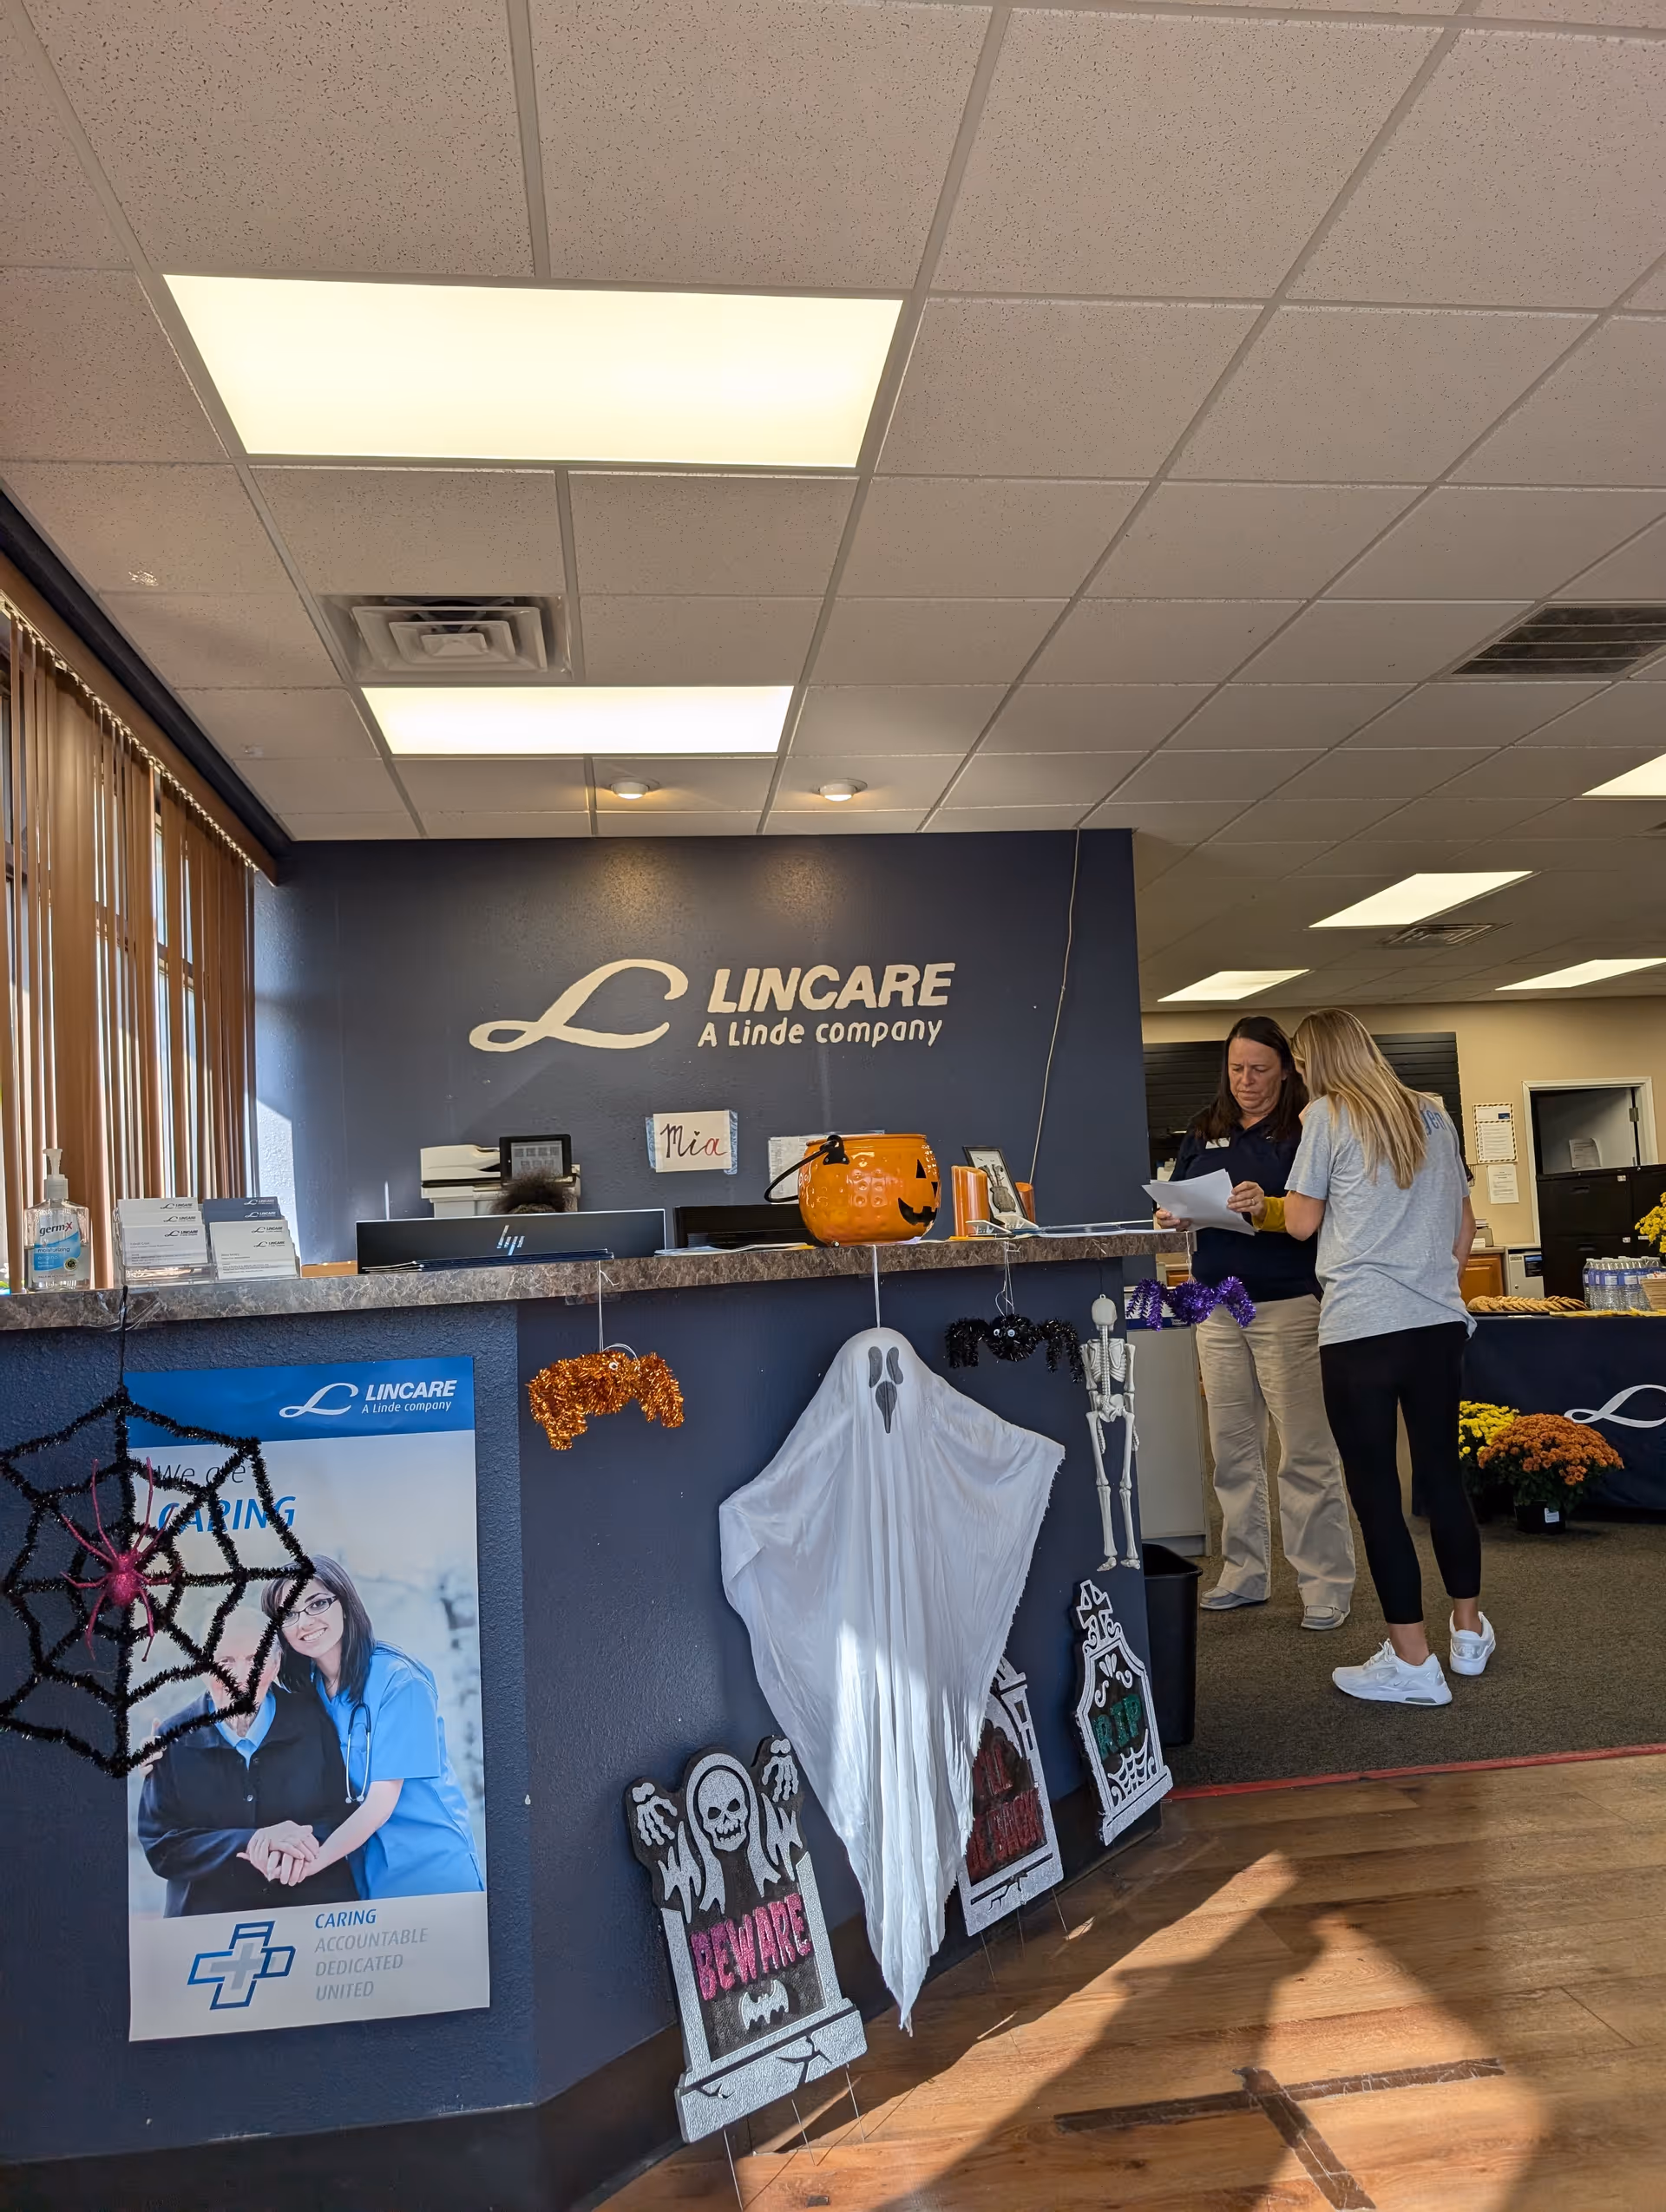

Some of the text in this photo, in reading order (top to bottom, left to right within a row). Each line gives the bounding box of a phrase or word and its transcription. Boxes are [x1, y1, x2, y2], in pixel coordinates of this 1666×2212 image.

[706, 962, 955, 1013] LINCARE
[697, 1017, 942, 1048] A Linde company
[659, 1123, 728, 1158] Mia
[39, 1221, 73, 1236] germ-X
[365, 1379, 458, 1401] LINCARE
[361, 1400, 452, 1414] A Linde company
[157, 1464, 246, 1483] We ae
[1093, 1694, 1142, 1761] RIP
[315, 1908, 377, 1929] CARING
[314, 1927, 429, 1953] ACCOUNTABLE
[690, 1892, 812, 2000] BEWARE
[315, 1953, 403, 1977] DEDICATED
[316, 1980, 374, 2001] UNITED
